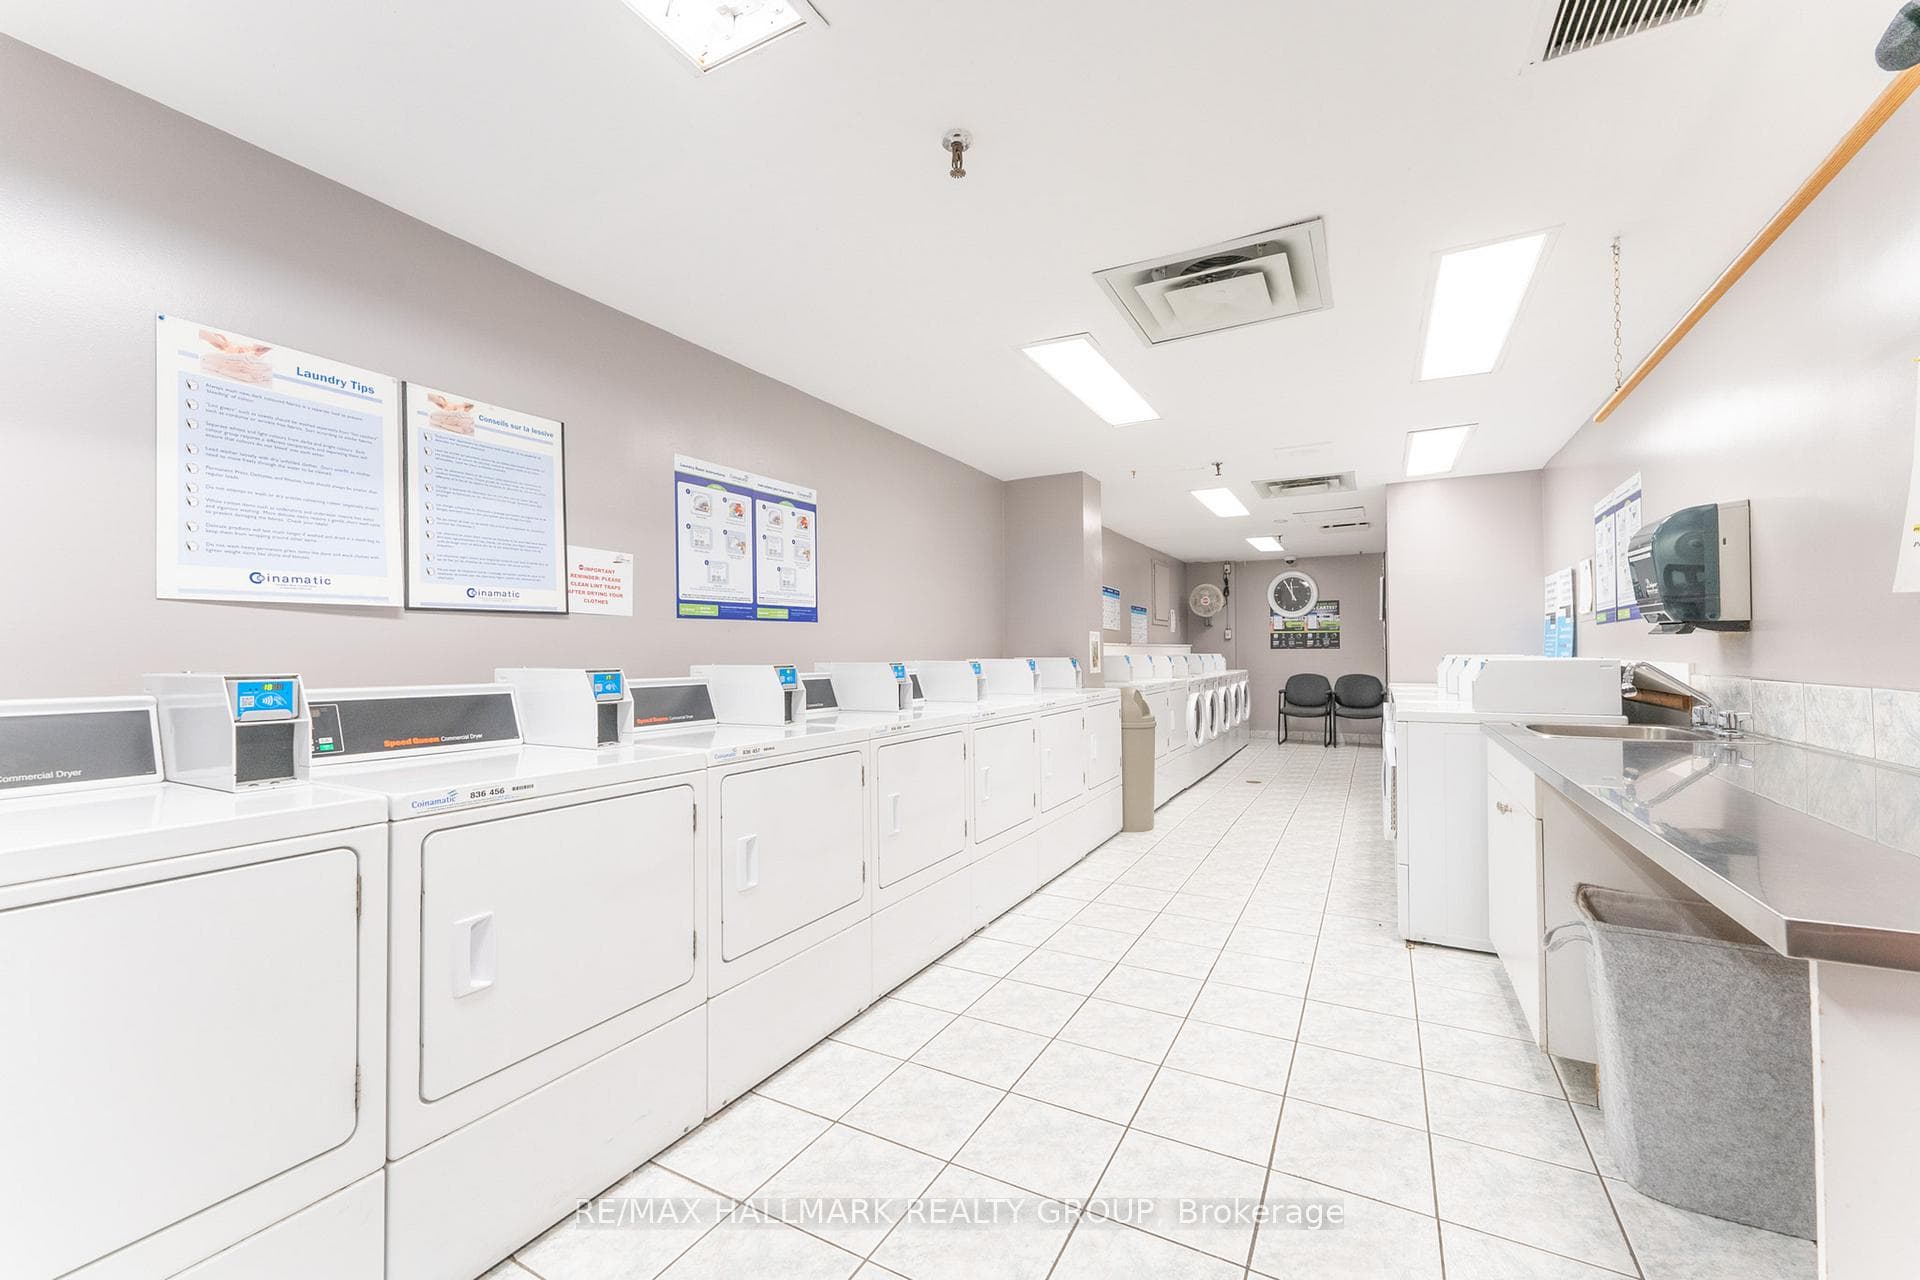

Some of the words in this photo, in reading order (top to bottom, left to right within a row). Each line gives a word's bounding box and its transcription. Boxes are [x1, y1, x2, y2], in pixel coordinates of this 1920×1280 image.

[296, 366, 347, 389] Laundry
[350, 380, 375, 395] Tips
[478, 414, 509, 428] Conseils
[531, 427, 554, 438] lessive
[249, 571, 332, 586] Coinamatic
[466, 587, 520, 599] Coinamatic
[383, 738, 412, 748] Speed
[440, 733, 469, 742] Commercial
[55, 769, 82, 779] Dryer
[411, 792, 456, 809] Coinamatic
[470, 789, 487, 799] 836
[489, 786, 505, 796] 456
